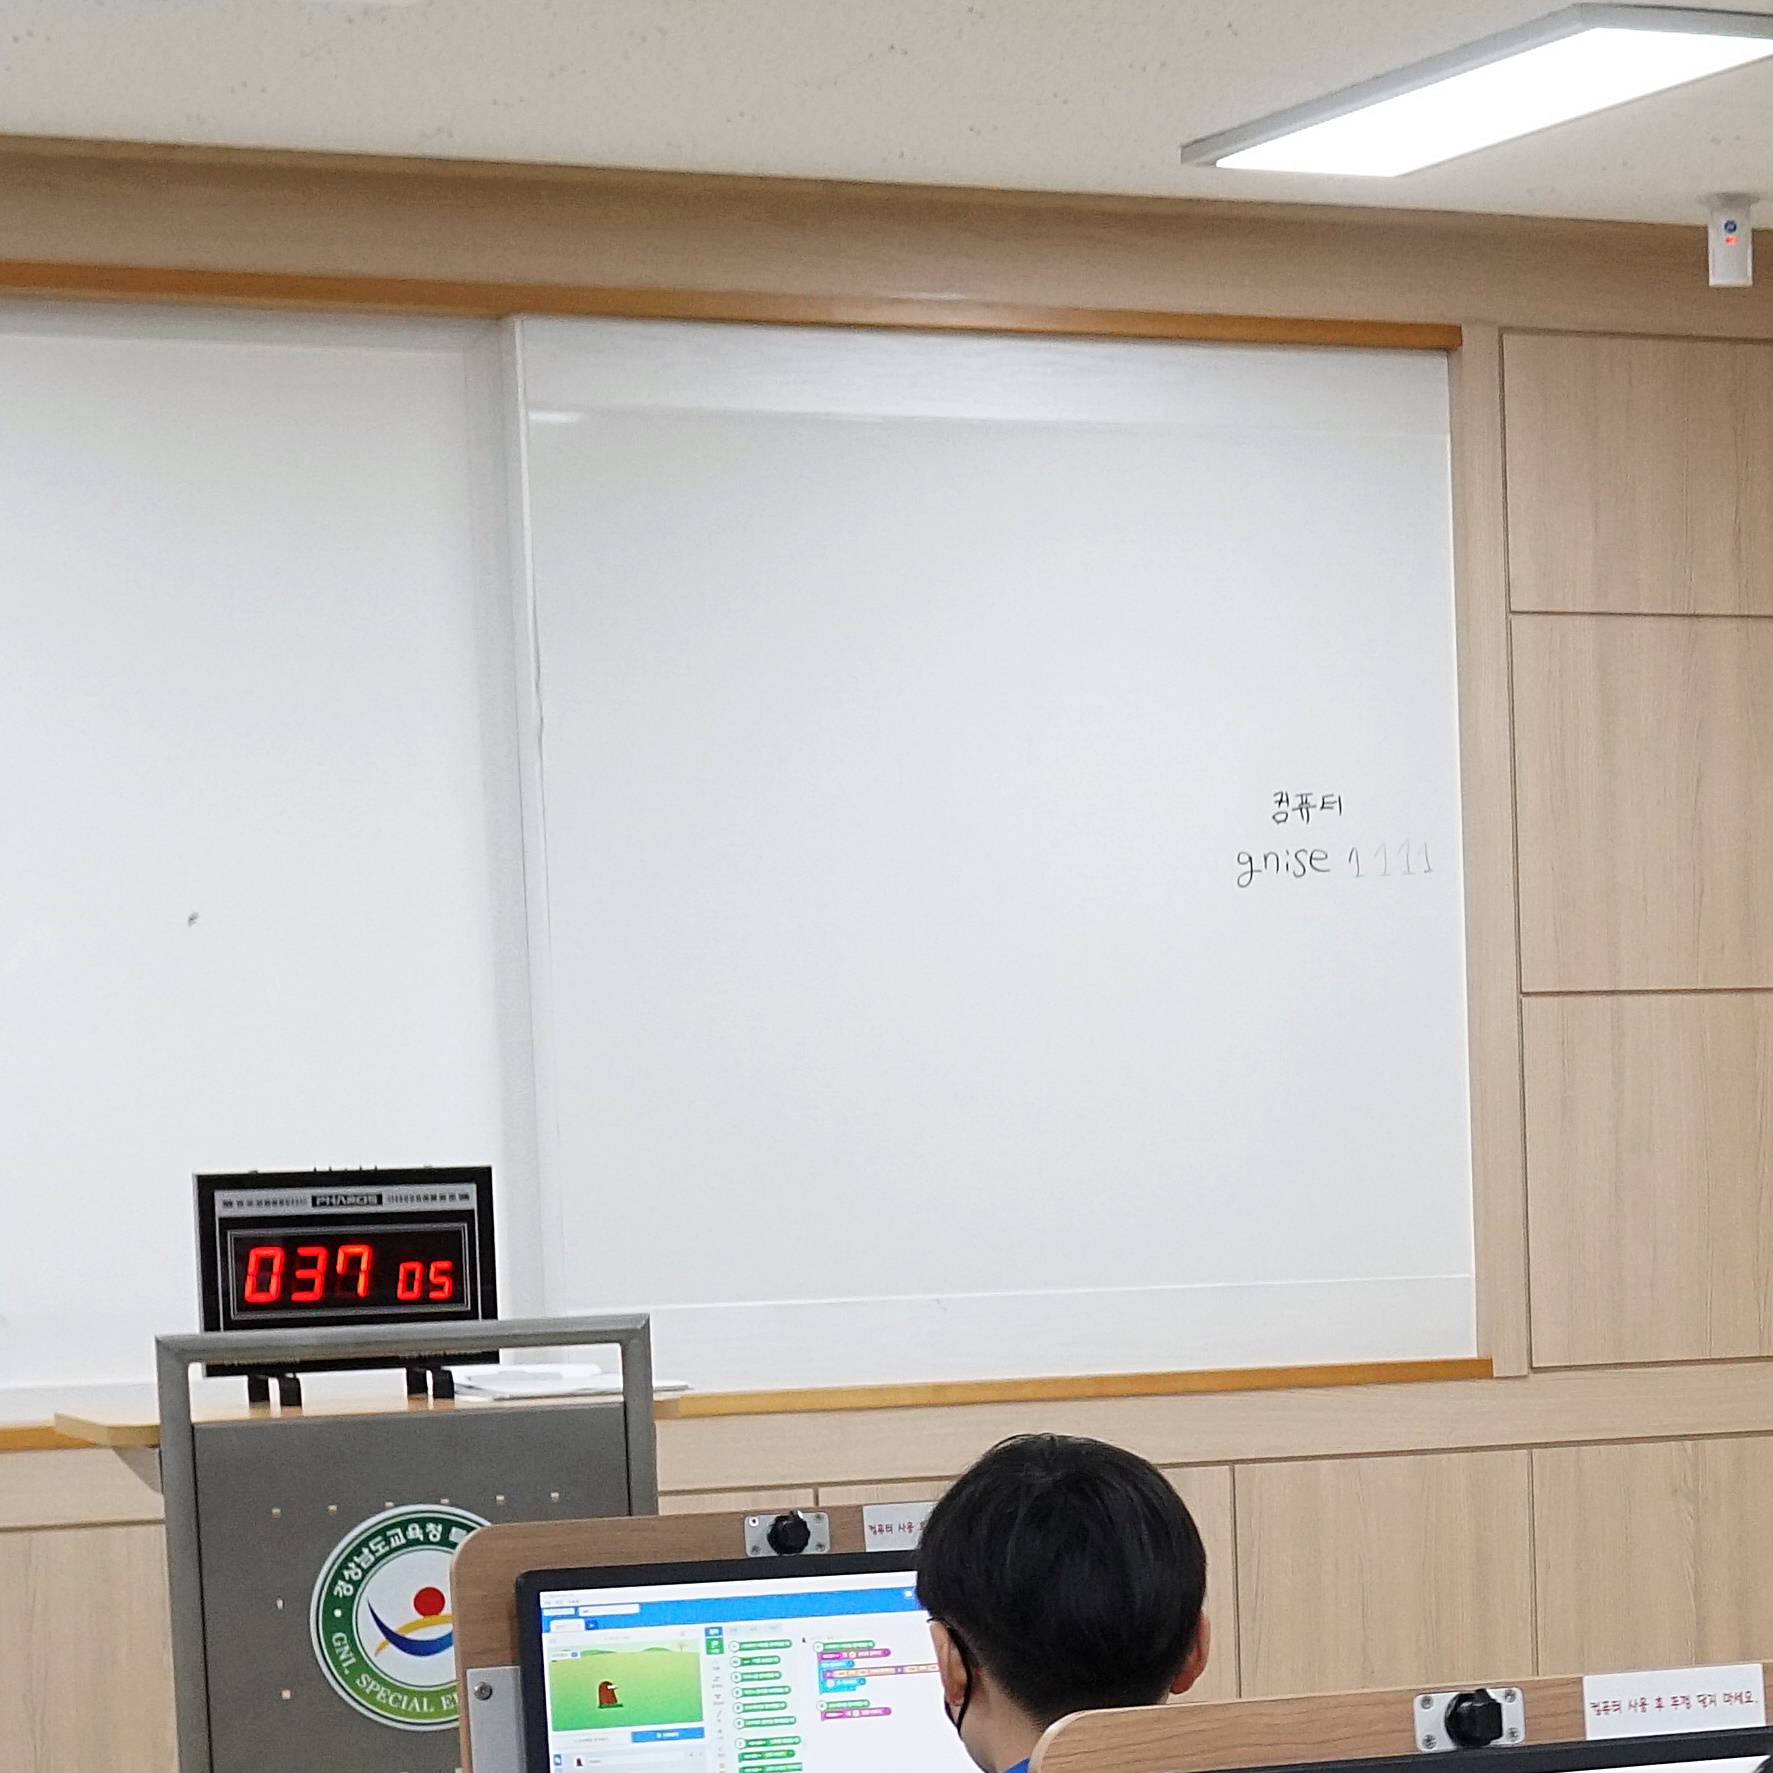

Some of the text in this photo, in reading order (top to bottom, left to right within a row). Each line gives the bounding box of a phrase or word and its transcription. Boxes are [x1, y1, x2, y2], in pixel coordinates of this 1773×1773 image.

[1237, 848, 1331, 888] gnise
[244, 1245, 453, 1303] 037 05
[333, 1522, 442, 1599] 경상남도교육청
[356, 1672, 434, 1714] SPECIAL
[1627, 1696, 1649, 1713] 사용
